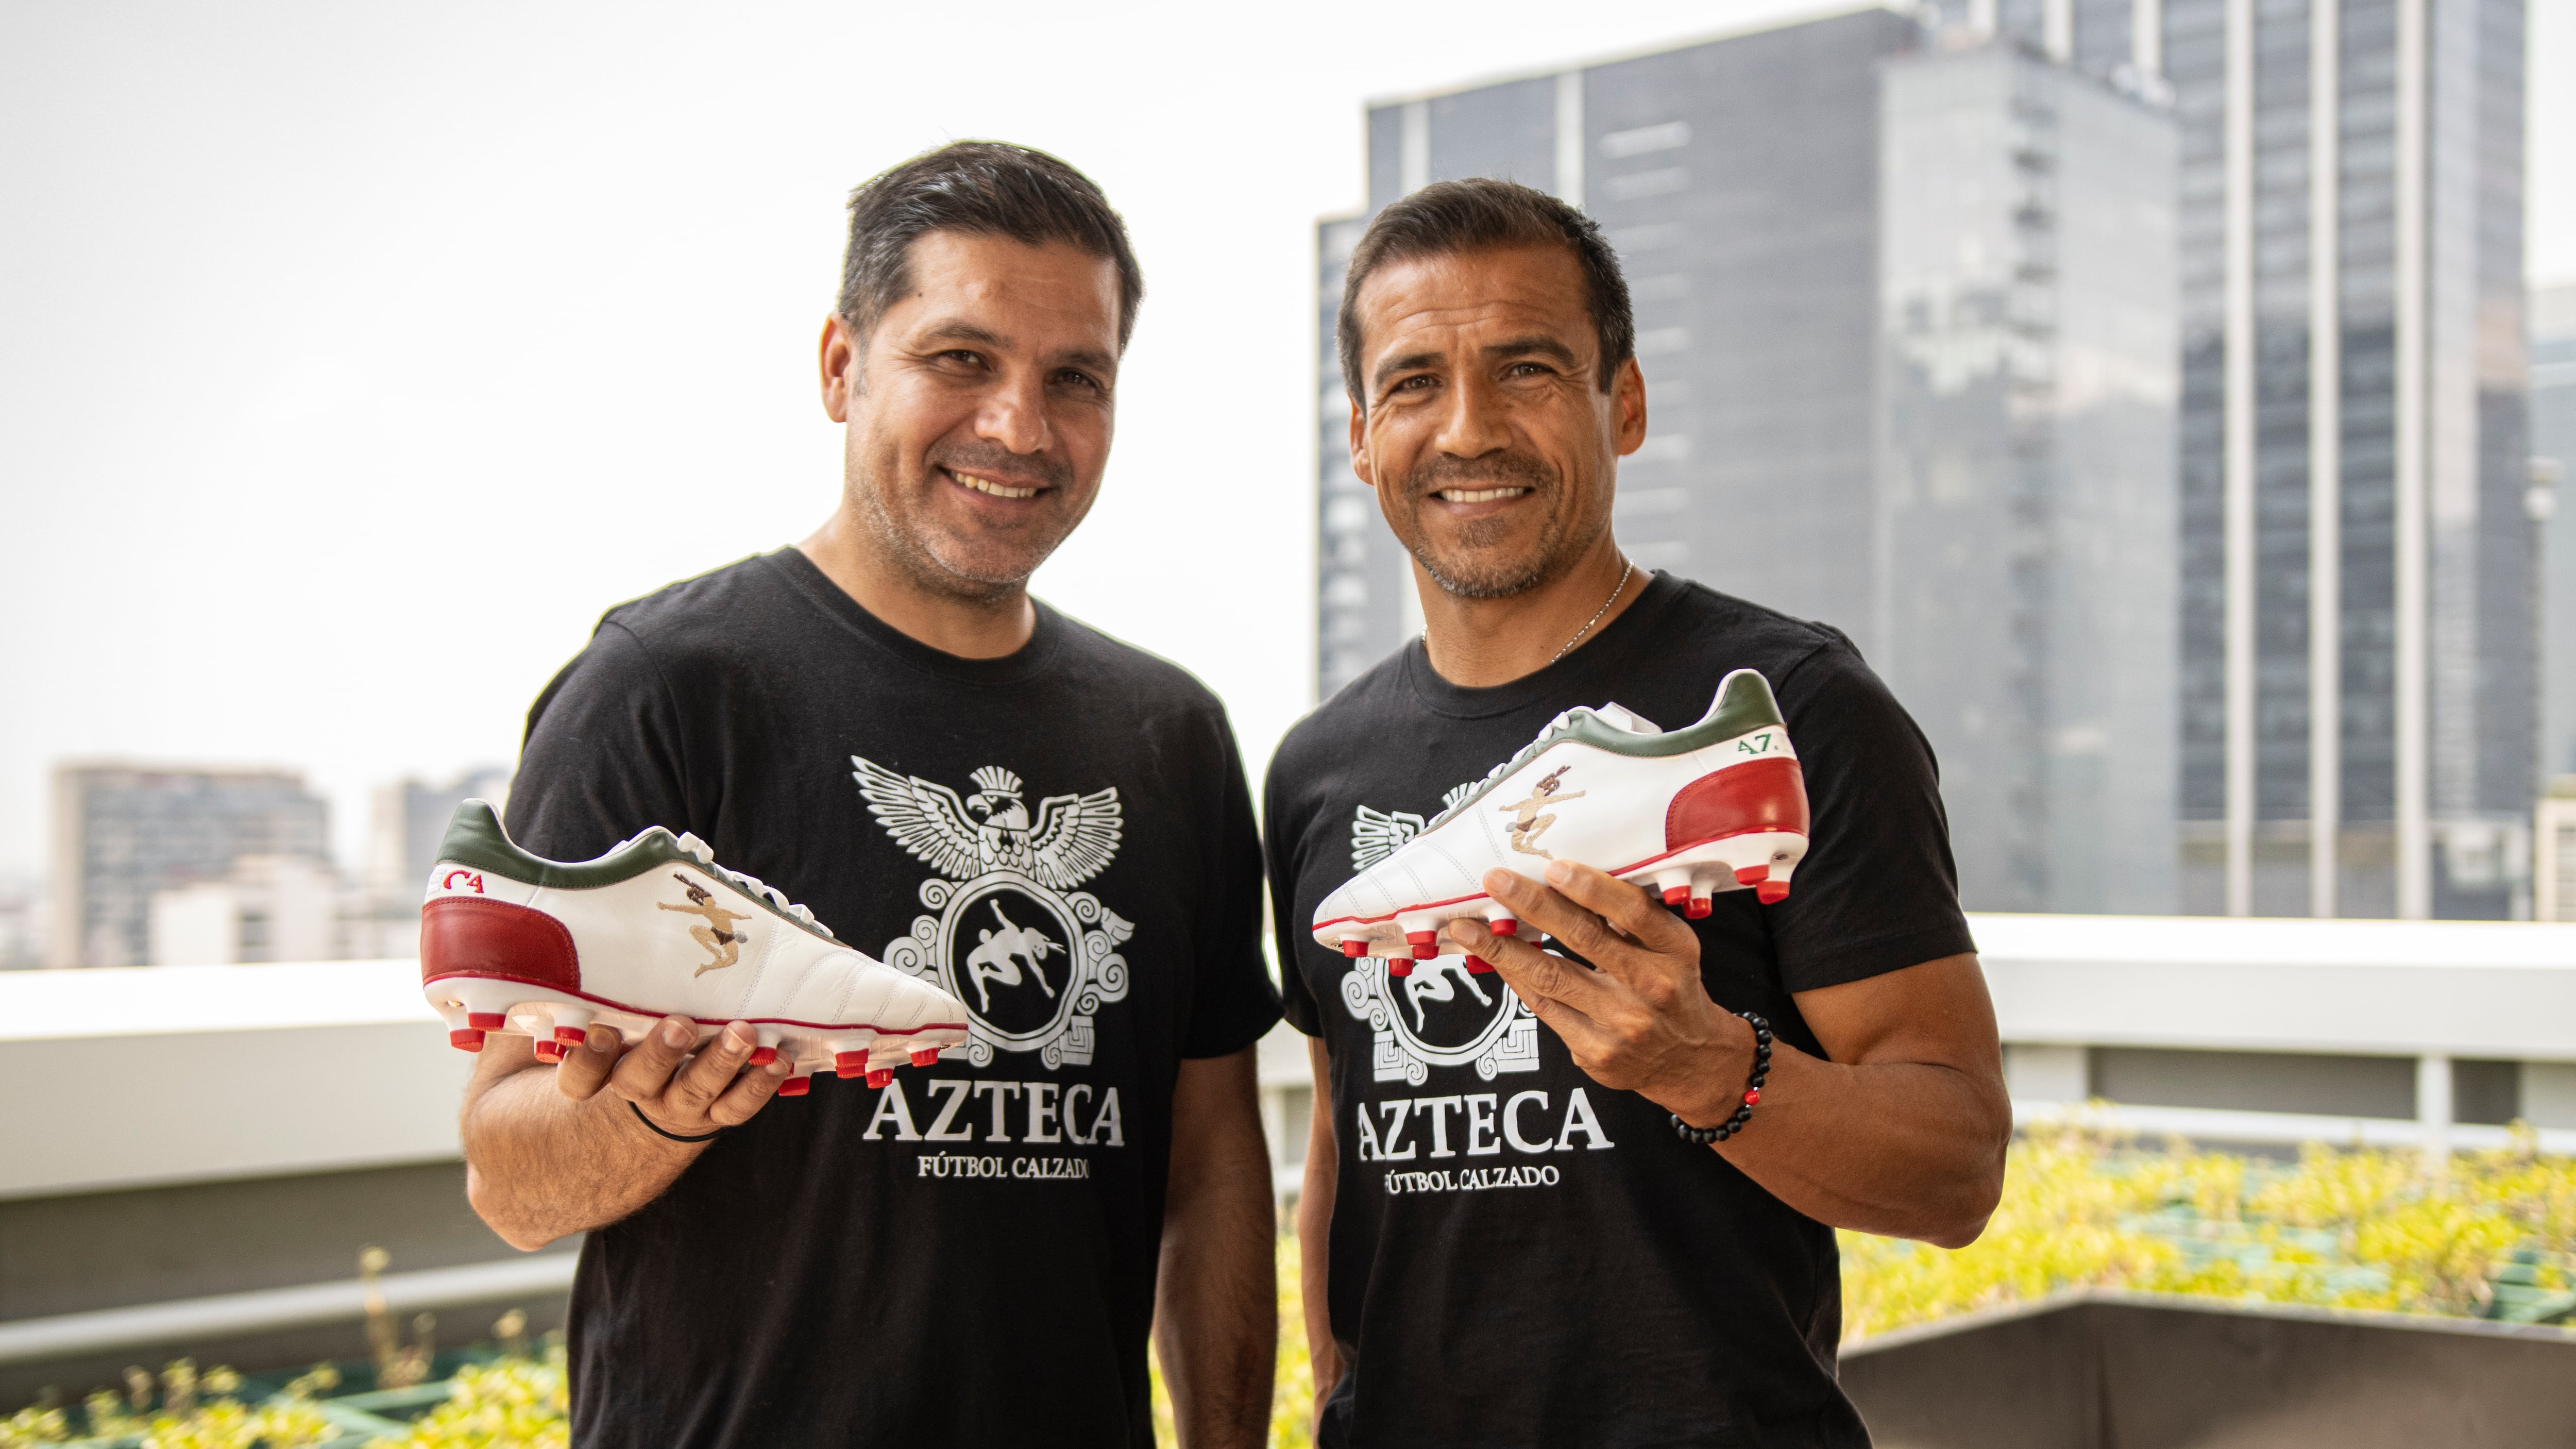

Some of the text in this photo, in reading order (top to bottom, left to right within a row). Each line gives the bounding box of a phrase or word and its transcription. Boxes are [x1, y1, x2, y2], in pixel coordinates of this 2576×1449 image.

[862, 1078, 1125, 1147] AZTECA
[1358, 1087, 1615, 1161] AZTECA
[918, 1151, 1090, 1179] FÚTBOL CALZADO
[1460, 1165, 1560, 1191] CALZADO
